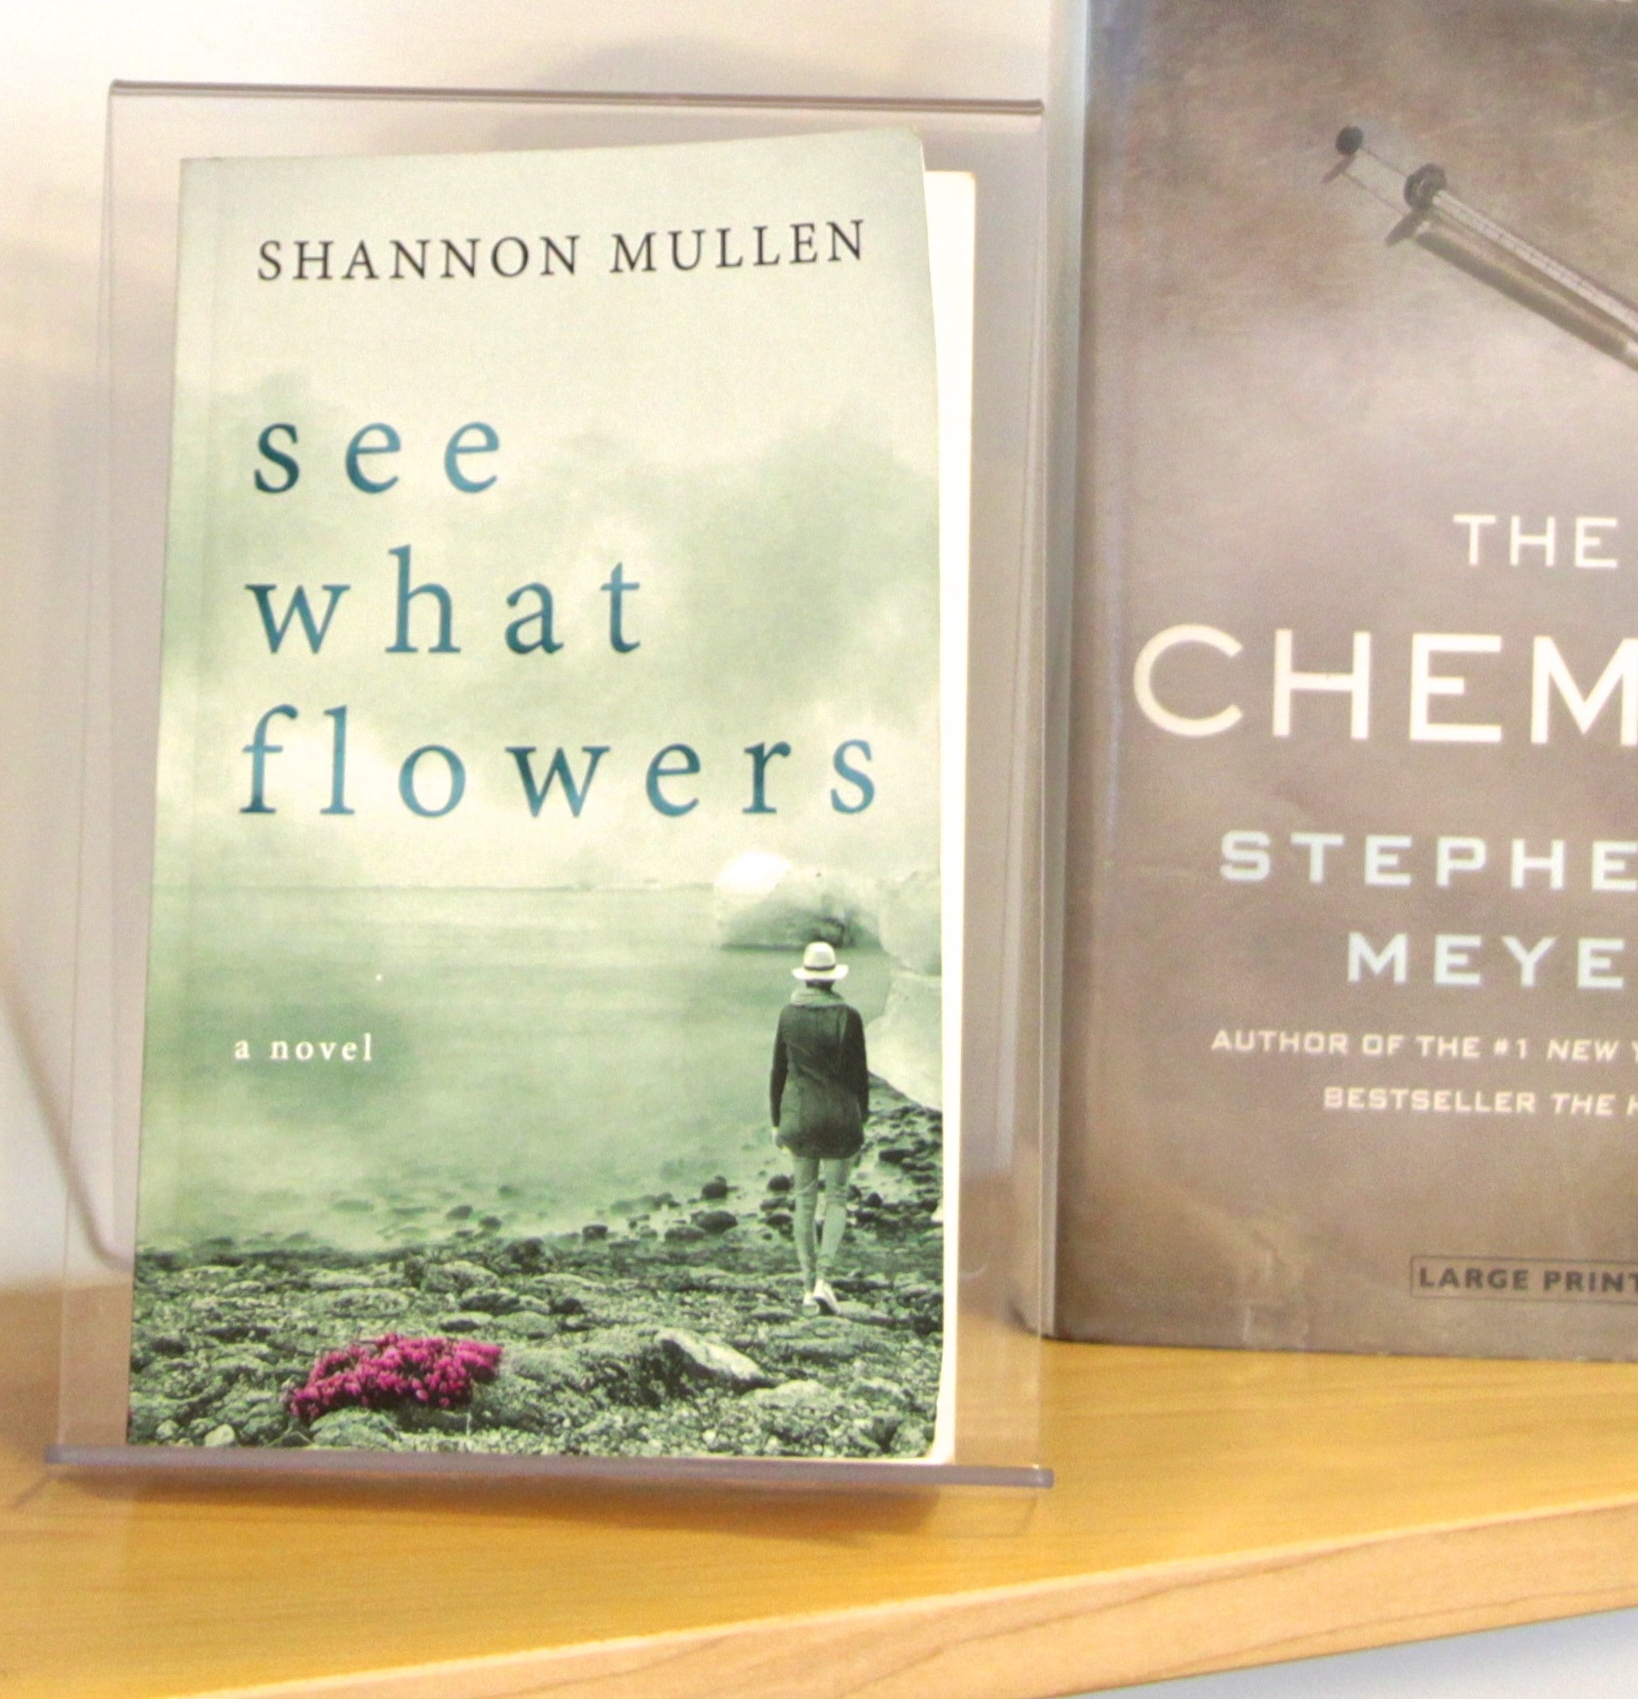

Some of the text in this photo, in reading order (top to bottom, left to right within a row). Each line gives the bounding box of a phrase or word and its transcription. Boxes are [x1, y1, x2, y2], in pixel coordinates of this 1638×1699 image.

[256, 219, 866, 281] SHANNON MULLEN
[253, 421, 500, 495] see
[1453, 513, 1620, 570] THE
[244, 543, 641, 655] what
[238, 703, 876, 819] flowers
[234, 1032, 375, 1062] a novel
[1211, 1030, 1349, 1056] AUTHOR
[1361, 1033, 1405, 1058] OF
[1415, 1035, 1481, 1059] THE
[1493, 1037, 1529, 1061] #1
[1546, 1038, 1620, 1063] NEW
[1322, 1085, 1537, 1116] BESTSELLER
[1550, 1091, 1615, 1117] THE
[1418, 1266, 1530, 1292] LARGE
